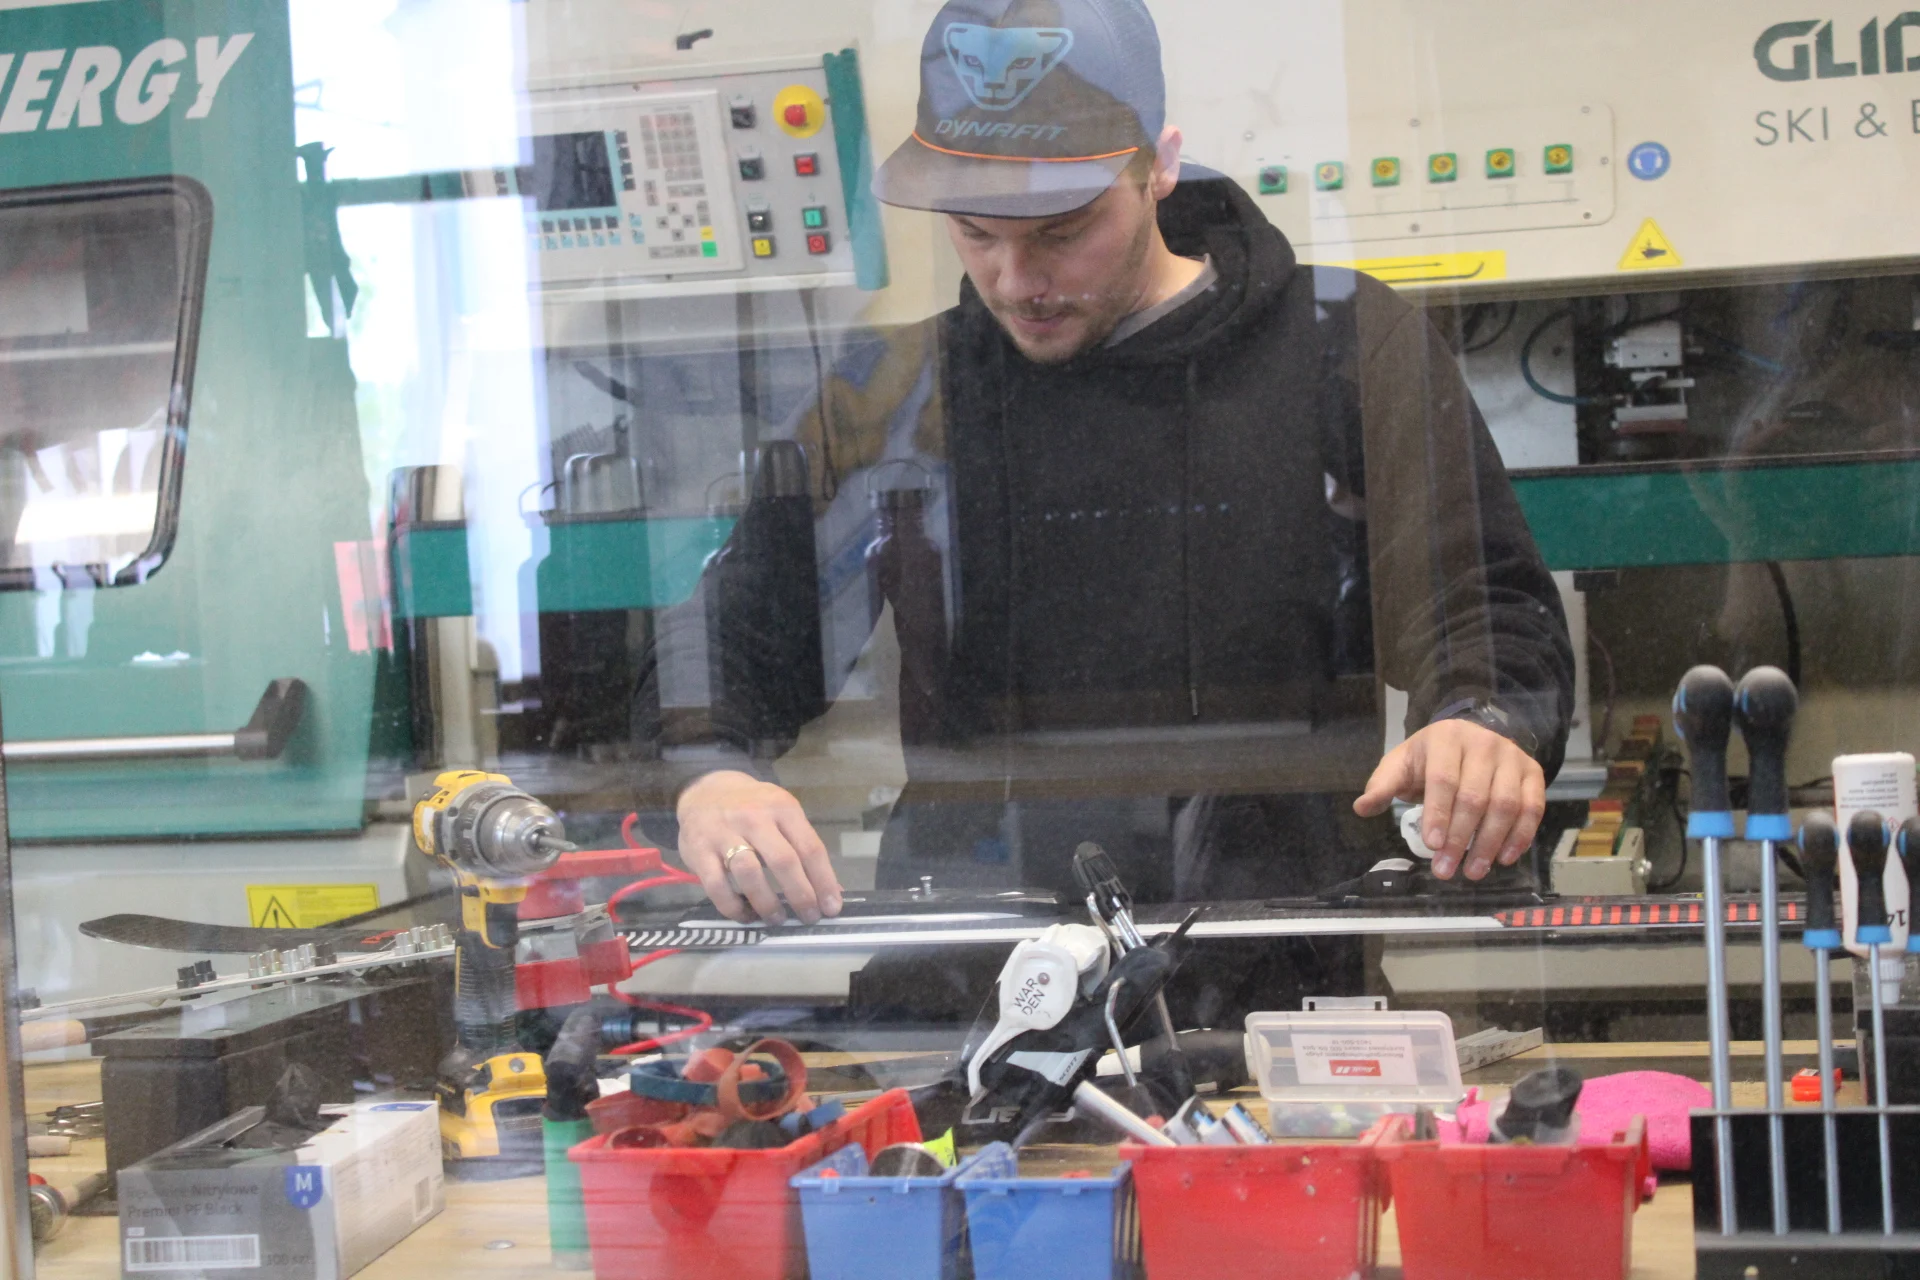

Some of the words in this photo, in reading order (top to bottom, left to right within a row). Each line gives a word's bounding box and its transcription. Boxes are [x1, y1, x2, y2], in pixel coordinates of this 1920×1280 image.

[0, 32, 255, 134] ERGY
[934, 119, 1068, 141] DYNAFIT
[1754, 106, 1829, 147] SKI
[1854, 102, 1889, 139] &
[1013, 977, 1039, 1008] WAR
[1021, 988, 1046, 1016] DEN
[295, 1172, 312, 1192] M
